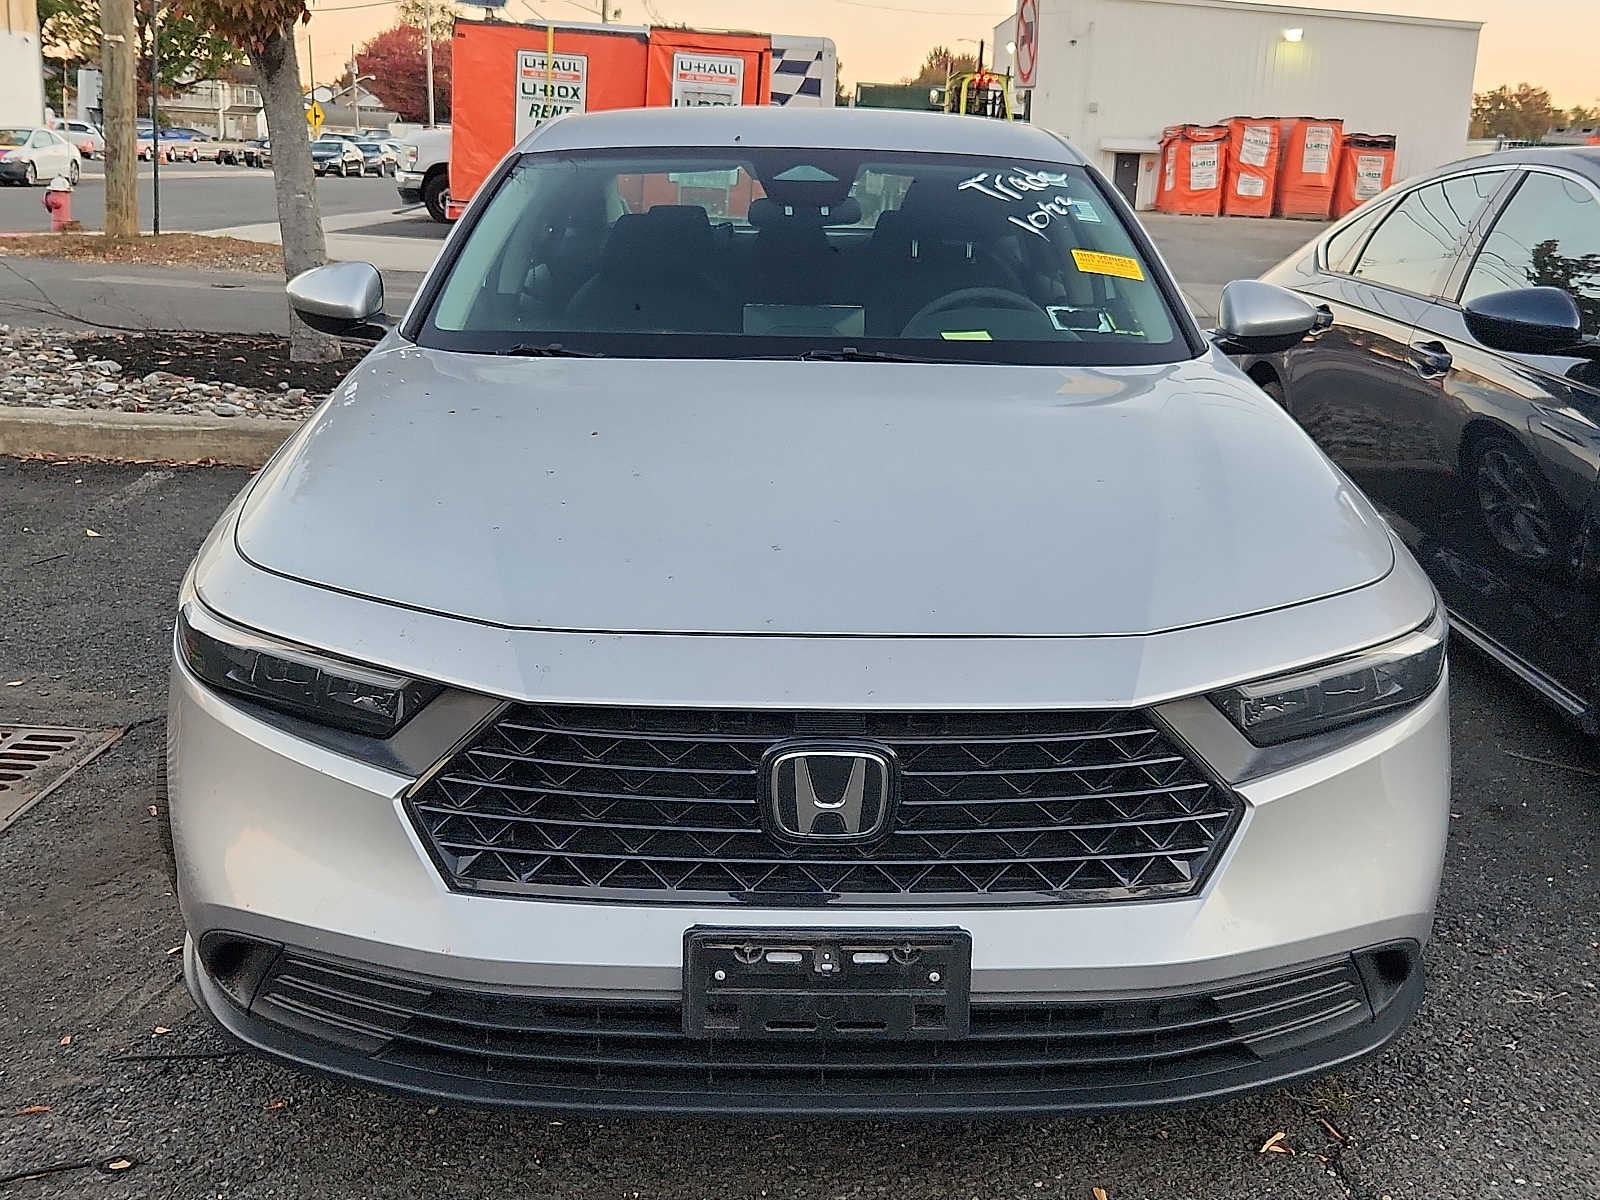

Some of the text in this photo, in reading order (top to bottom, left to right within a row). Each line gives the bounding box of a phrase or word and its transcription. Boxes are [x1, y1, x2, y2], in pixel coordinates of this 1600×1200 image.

[524, 57, 580, 72] U-HAUL
[680, 60, 736, 75] U-HAUL
[521, 82, 581, 100] U-BOX
[529, 103, 574, 119] RENT
[957, 166, 1069, 202] Trade
